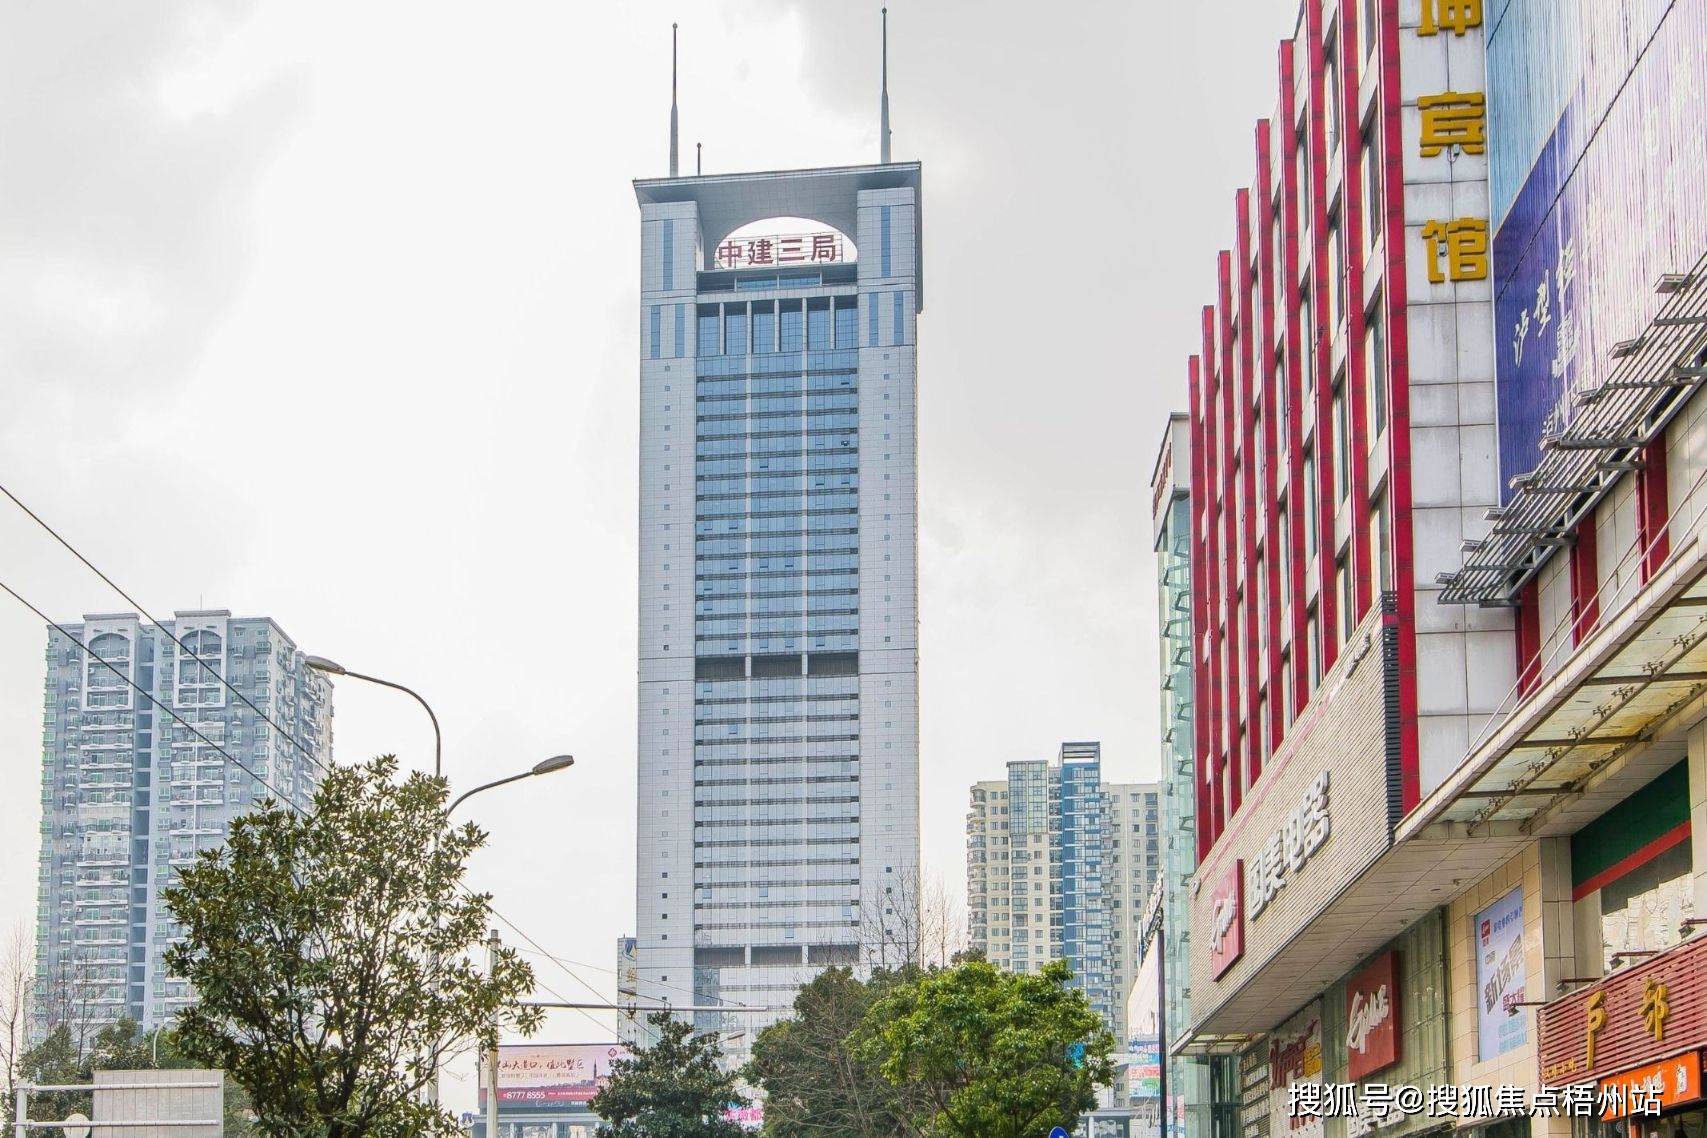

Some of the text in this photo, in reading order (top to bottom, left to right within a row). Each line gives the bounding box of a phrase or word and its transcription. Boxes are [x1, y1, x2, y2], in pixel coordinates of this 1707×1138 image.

[717, 233, 837, 267] 中建三局
[1249, 770, 1330, 921] 国美电器
[1584, 975, 1670, 1071] 户部
